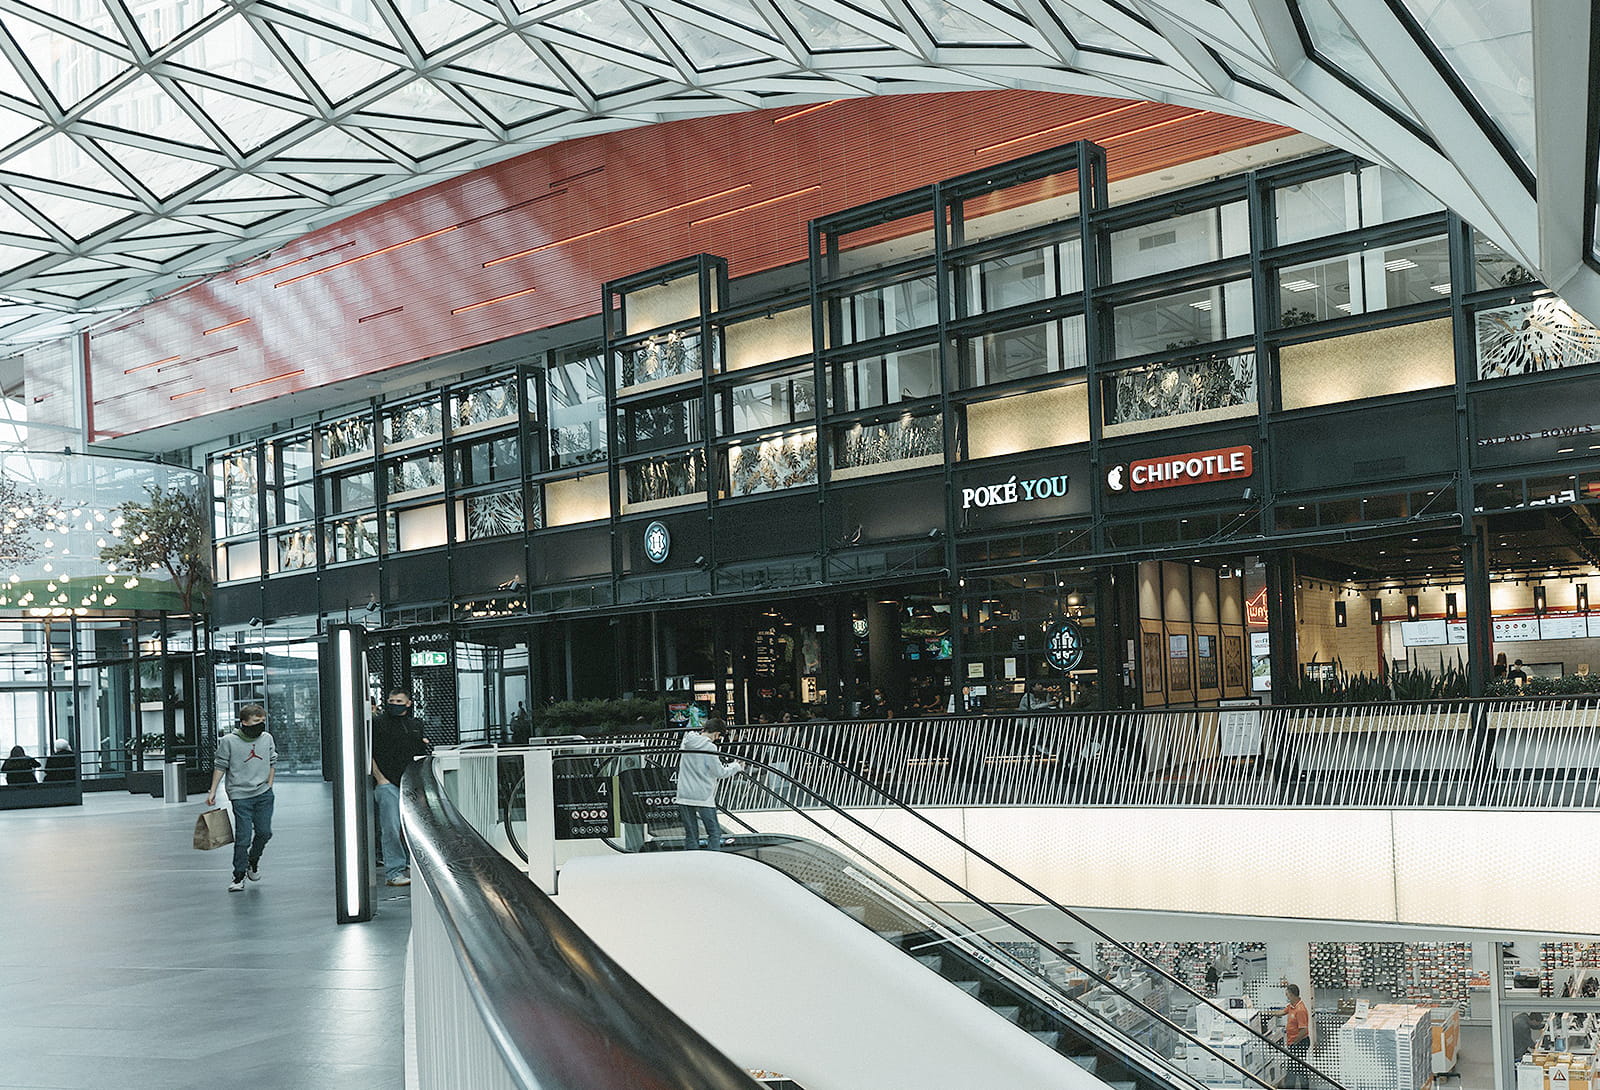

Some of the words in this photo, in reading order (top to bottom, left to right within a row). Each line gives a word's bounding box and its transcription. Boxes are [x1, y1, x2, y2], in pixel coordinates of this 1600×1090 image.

[1477, 432, 1531, 446] SALADS
[1541, 423, 1593, 438] BOWLS
[1132, 452, 1246, 485] CHIPOTLE
[962, 475, 1018, 509] POKÉ
[1020, 475, 1068, 501] YOU
[597, 782, 608, 796] 4
[669, 771, 679, 784] 4
